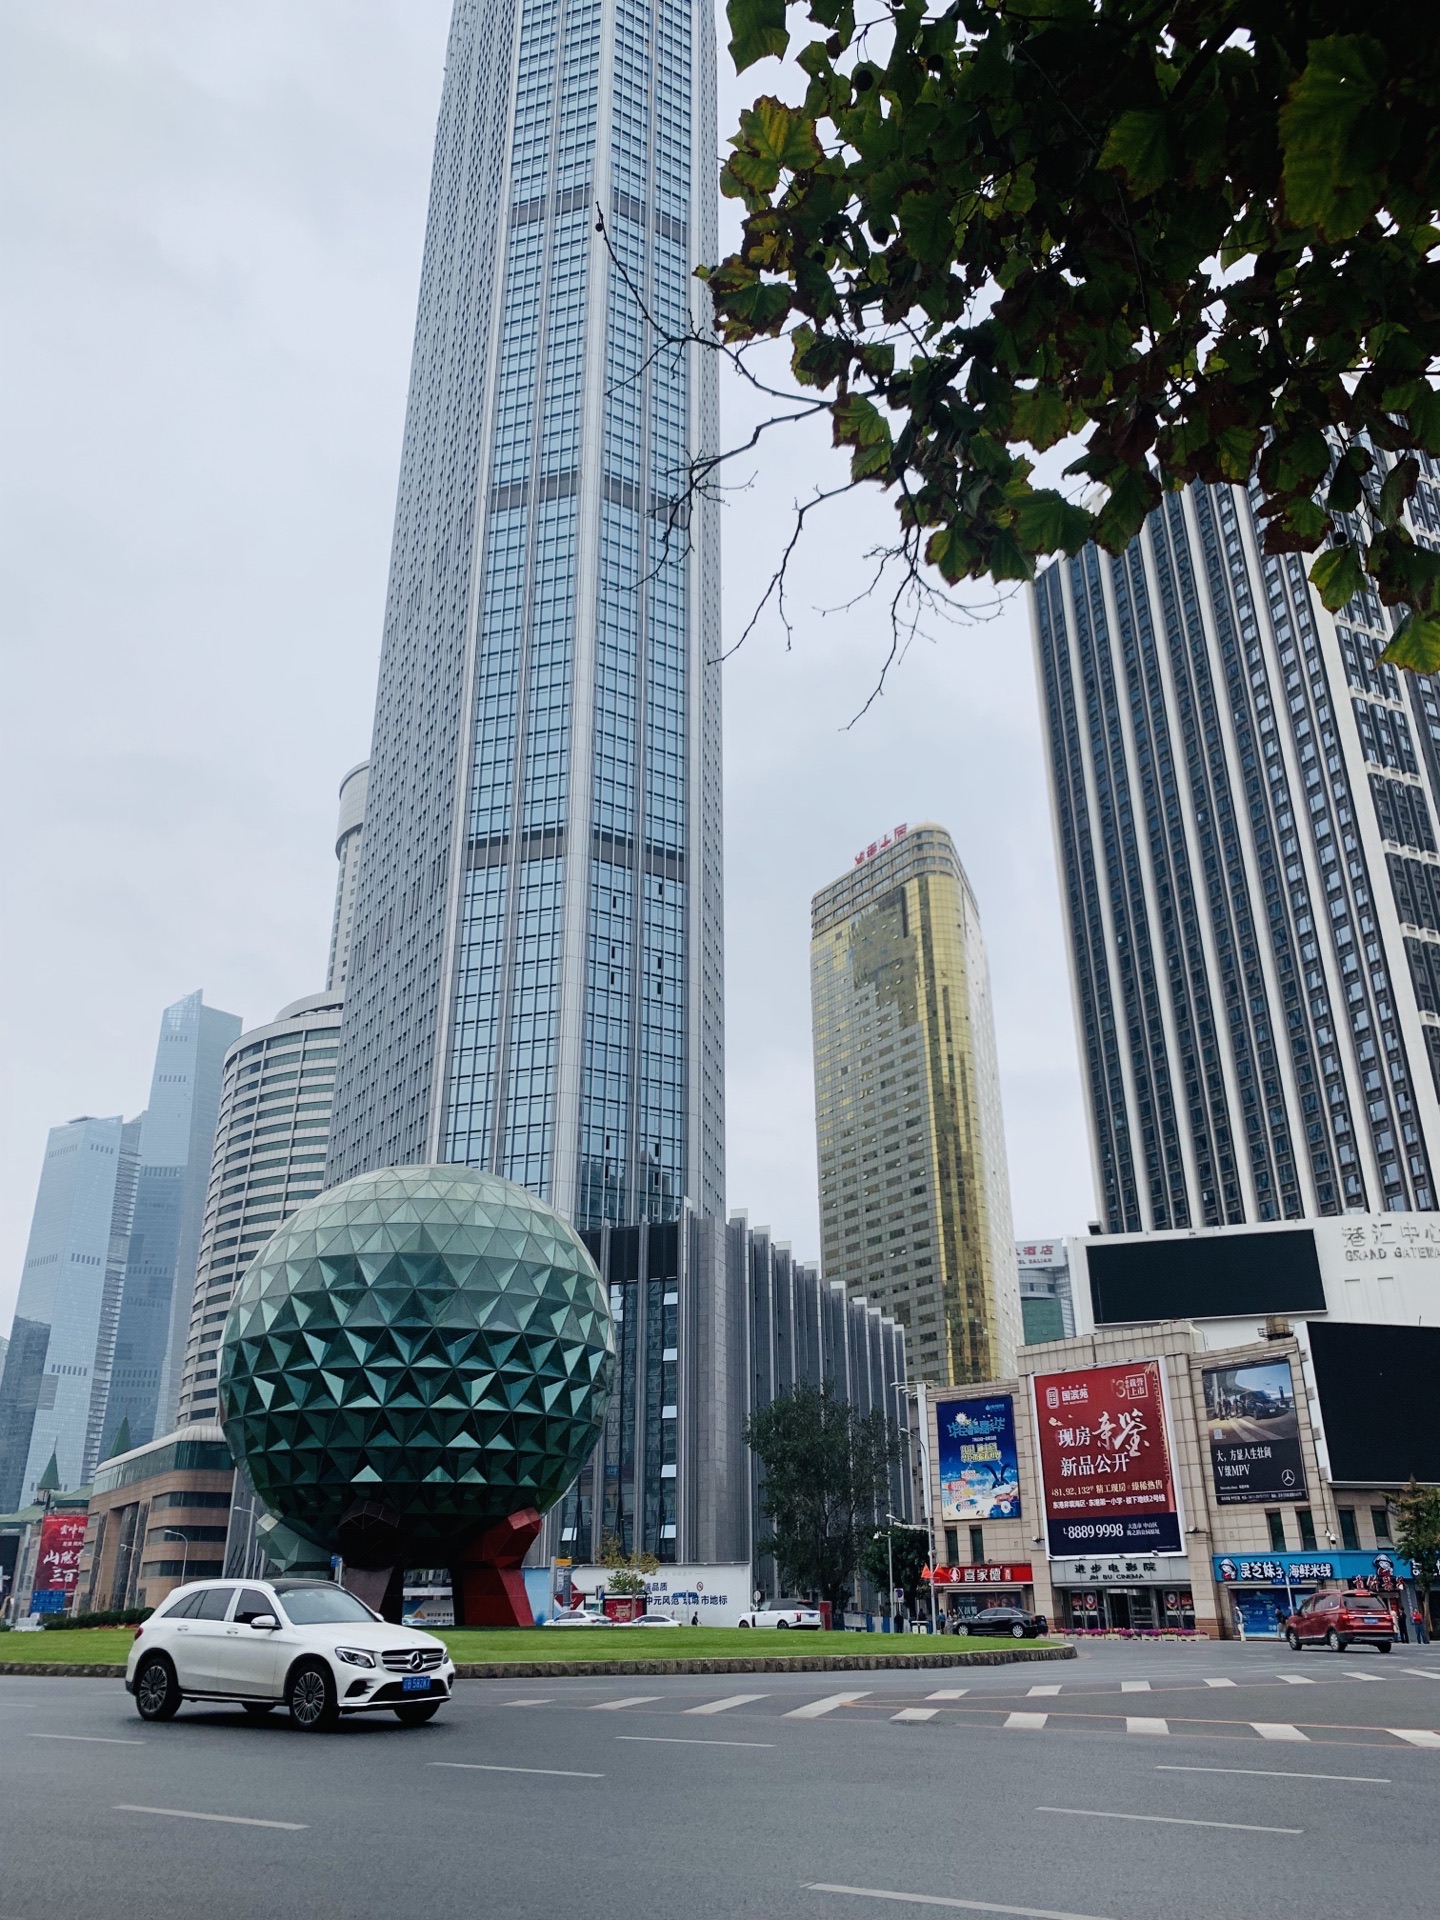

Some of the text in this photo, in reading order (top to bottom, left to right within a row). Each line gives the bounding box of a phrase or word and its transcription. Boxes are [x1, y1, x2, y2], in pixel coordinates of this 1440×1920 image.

[1345, 1247, 1387, 1261] GRAND
[1058, 1427, 1091, 1448] 现房
[1060, 1451, 1130, 1477] 新品公开
[1218, 1464, 1250, 1477] V级MPV
[1068, 1523, 1124, 1539] 8889 9998
[49, 1566, 80, 1582] 三百
[964, 1567, 1001, 1582] 喜家德
[1074, 1562, 1157, 1574] 进步电影院
[1240, 1561, 1332, 1578] 灵芝妹子 海鲜米线
